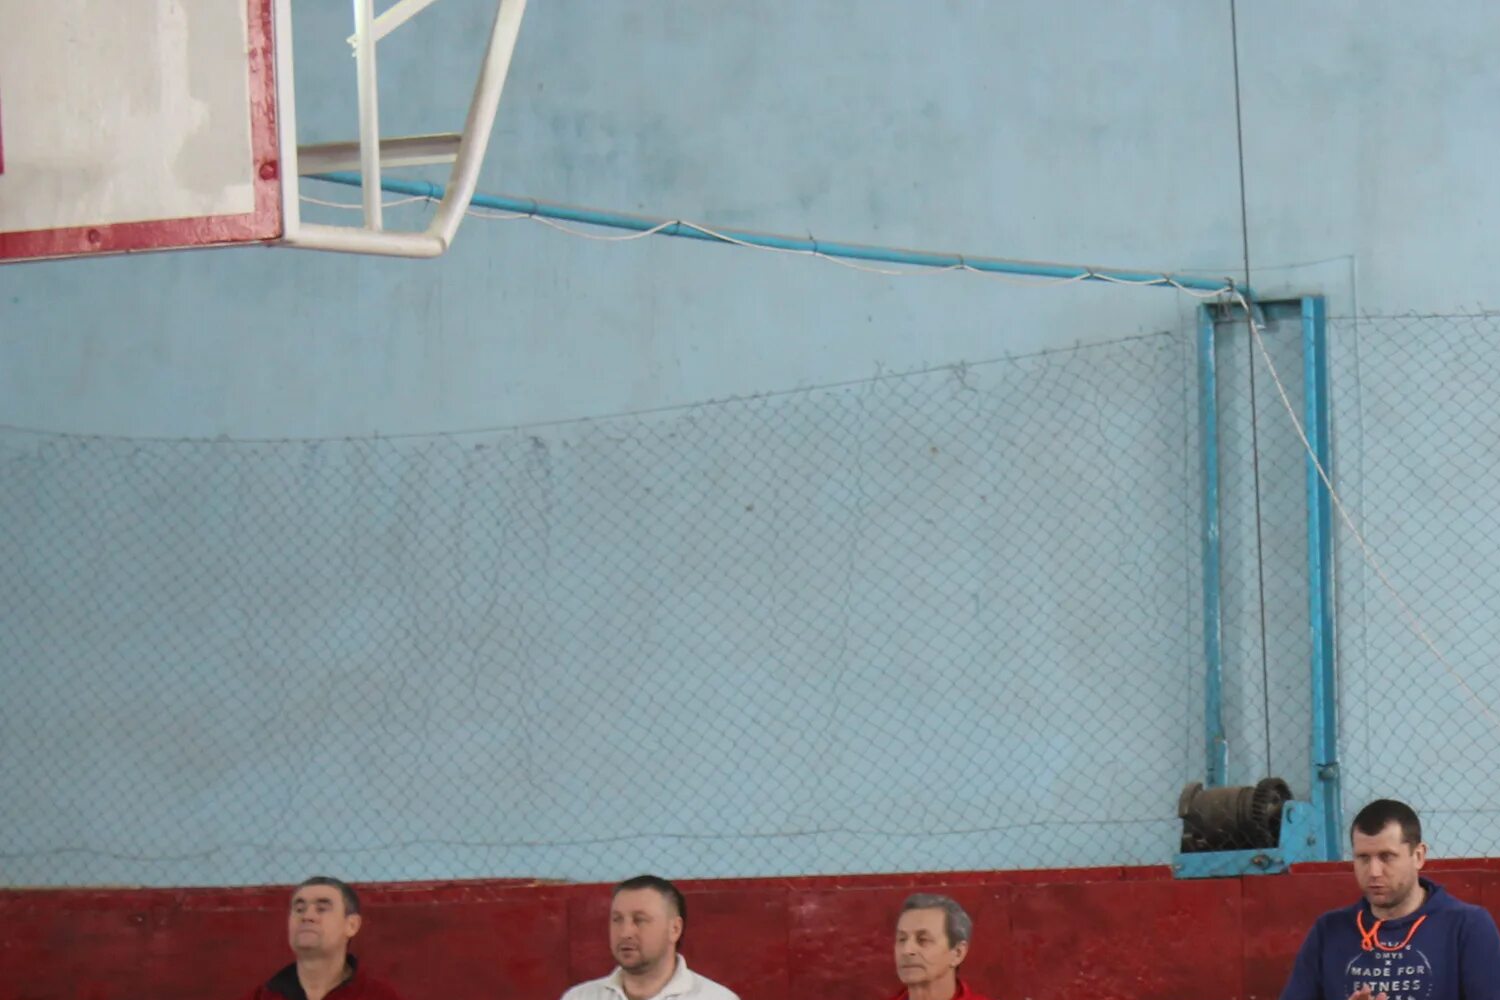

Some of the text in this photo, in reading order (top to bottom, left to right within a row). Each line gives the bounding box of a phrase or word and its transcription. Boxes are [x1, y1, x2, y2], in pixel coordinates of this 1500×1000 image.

[1351, 965, 1425, 977] MADE FOR
[1353, 980, 1421, 992] FTNESS
